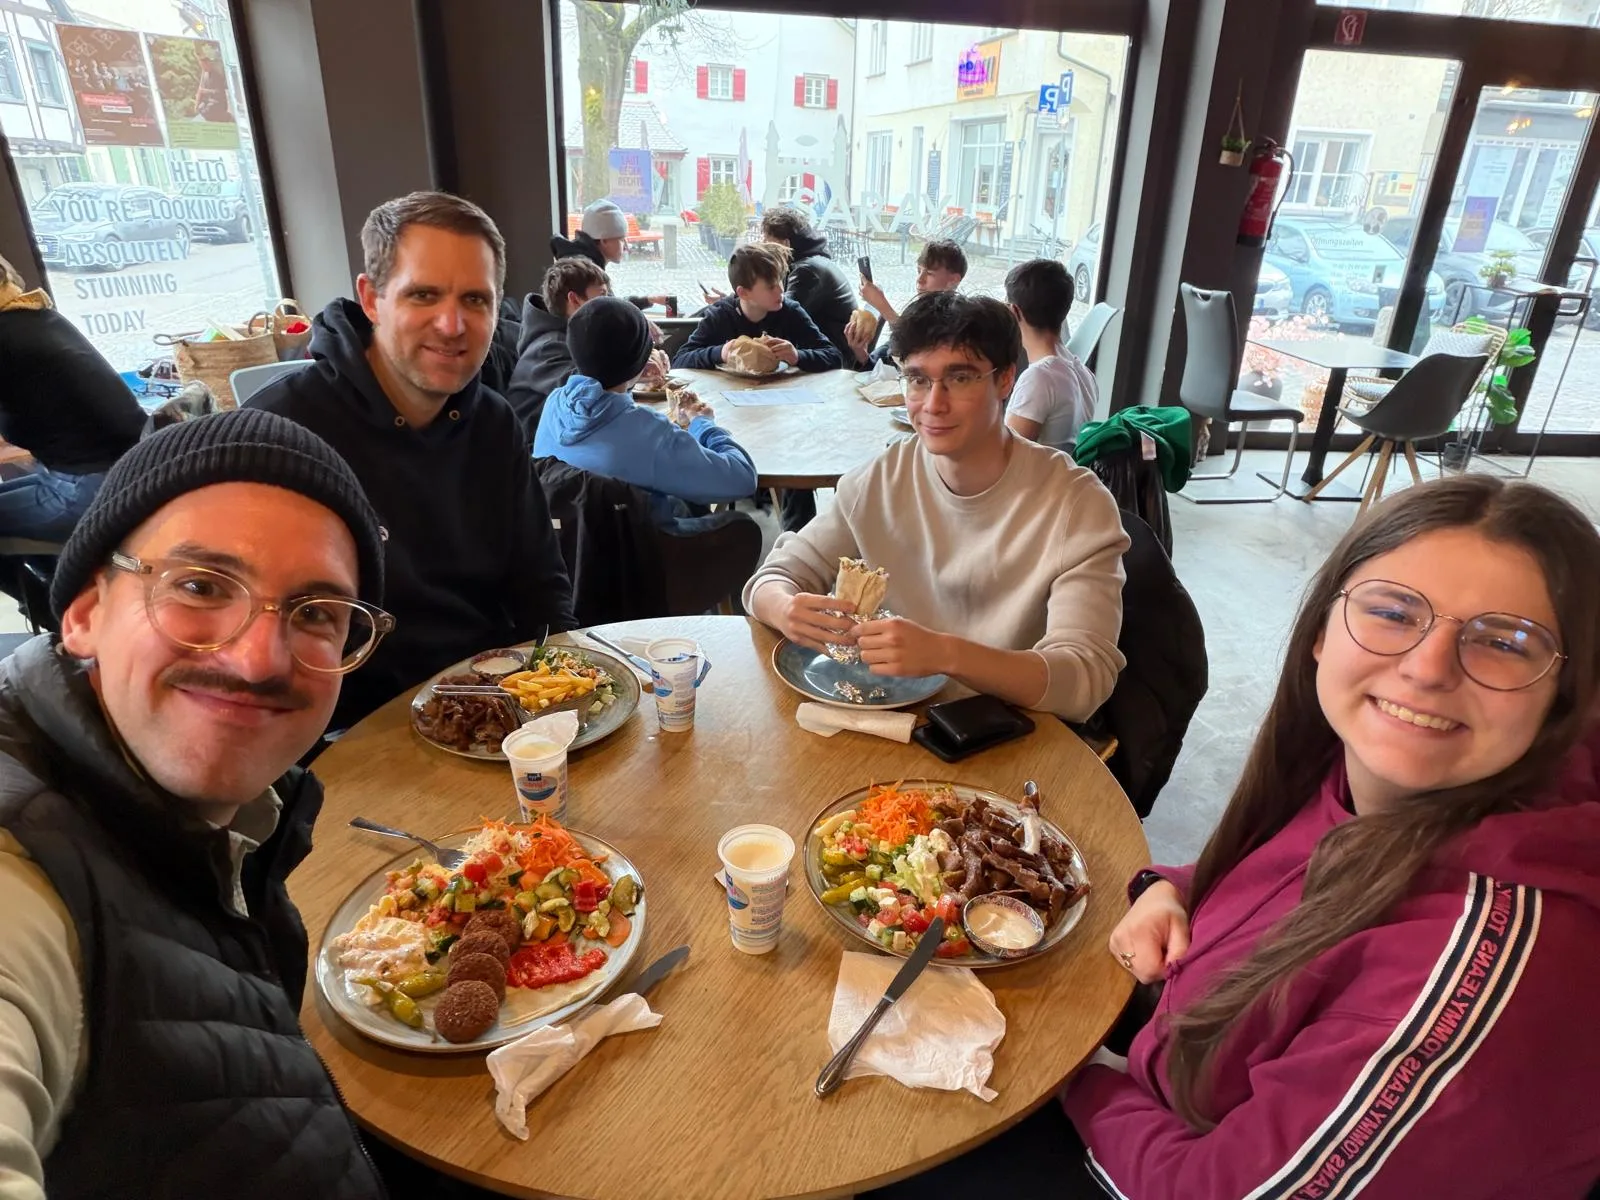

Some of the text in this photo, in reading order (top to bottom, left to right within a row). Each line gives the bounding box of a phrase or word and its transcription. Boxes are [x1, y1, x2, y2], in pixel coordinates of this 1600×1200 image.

[52, 200, 134, 222] YOU'RE
[65, 239, 189, 266] ABSOLUTELY
[74, 273, 177, 300] STUNNING
[80, 310, 145, 335] TODAY
